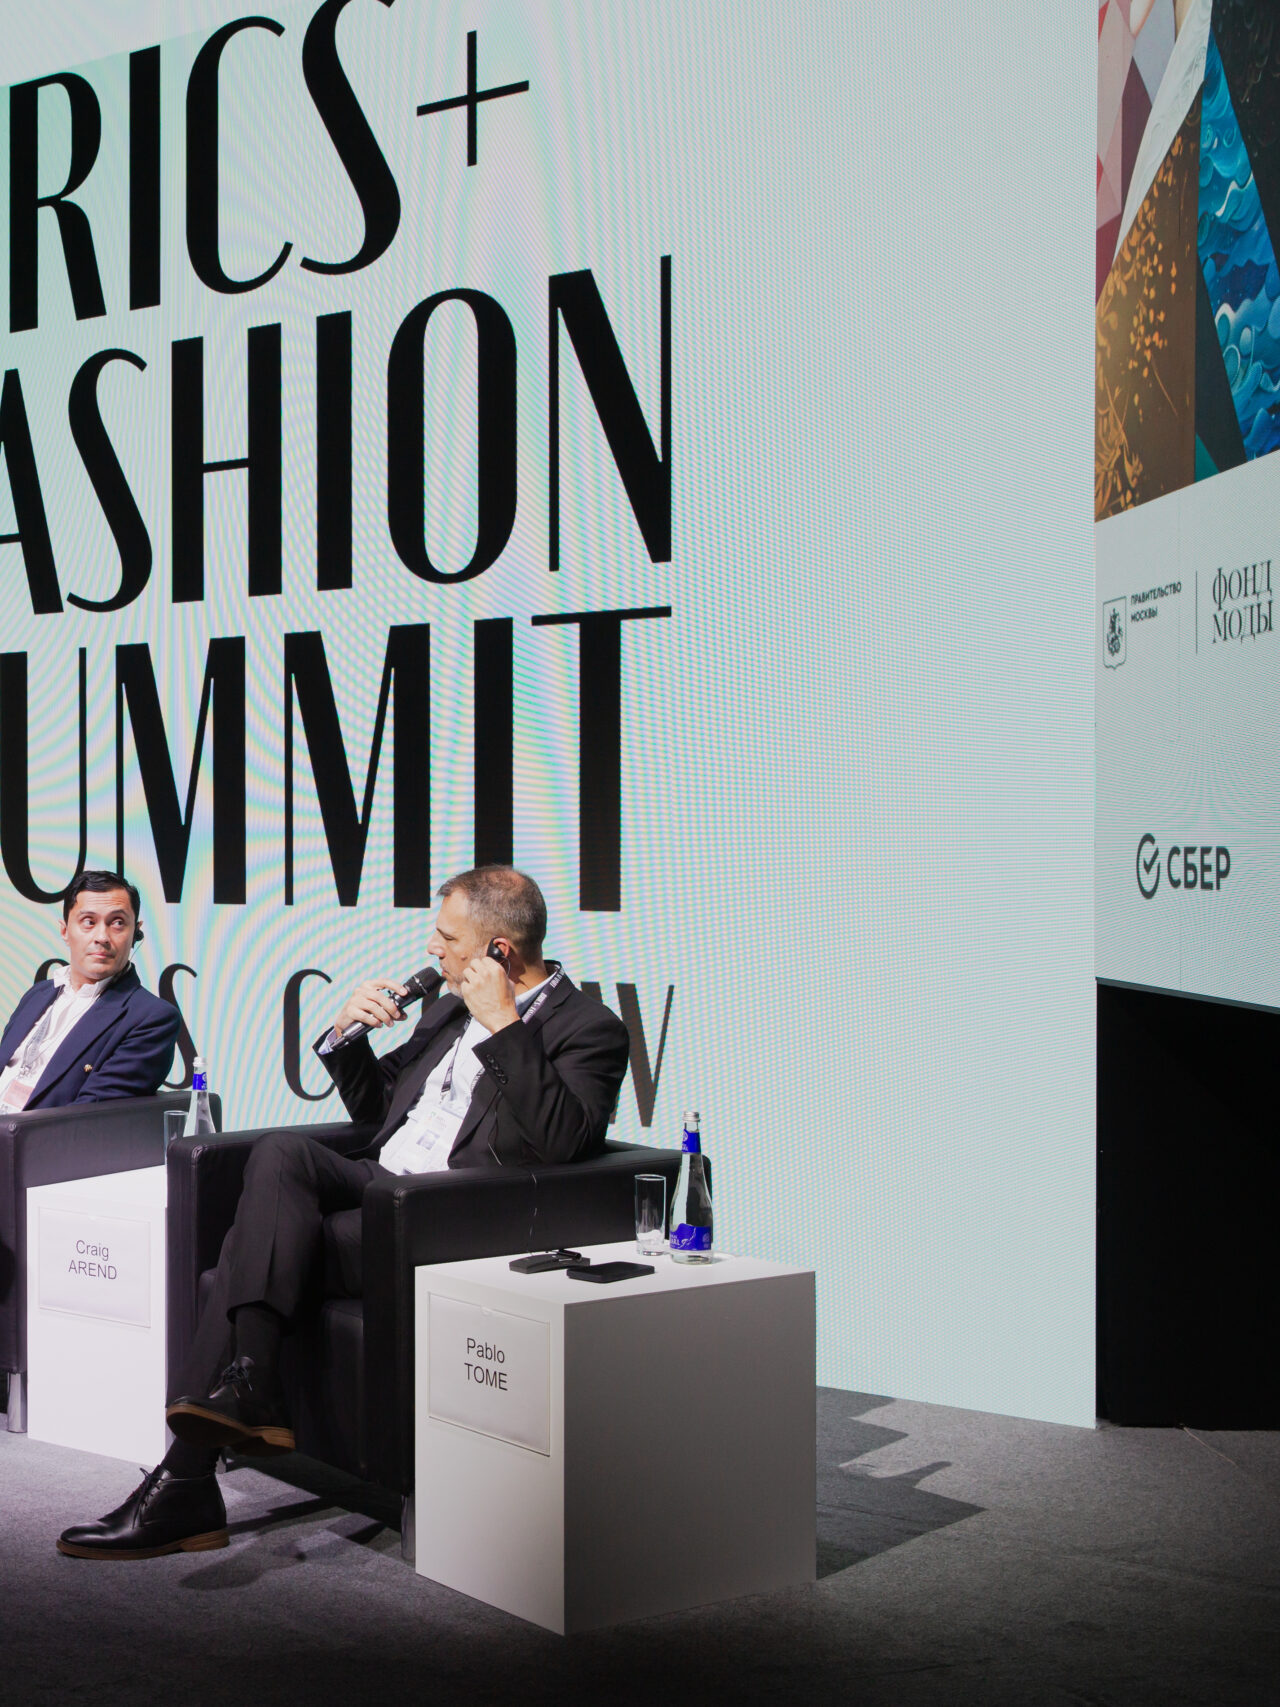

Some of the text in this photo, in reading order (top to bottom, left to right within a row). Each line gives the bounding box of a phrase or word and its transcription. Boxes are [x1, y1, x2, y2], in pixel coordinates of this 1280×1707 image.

[1131, 581, 1182, 605] ПРАВИТЕЛЬСТВО
[1212, 560, 1272, 611] ФОНД
[1131, 605, 1158, 622] МОСКВЫ
[1212, 600, 1272, 645] МОДЫ
[1167, 846, 1231, 890] СБЕР
[76, 1239, 109, 1261] Craig
[68, 1259, 117, 1280] AREND
[466, 1337, 506, 1364] Pablo
[464, 1362, 508, 1391] TOME
